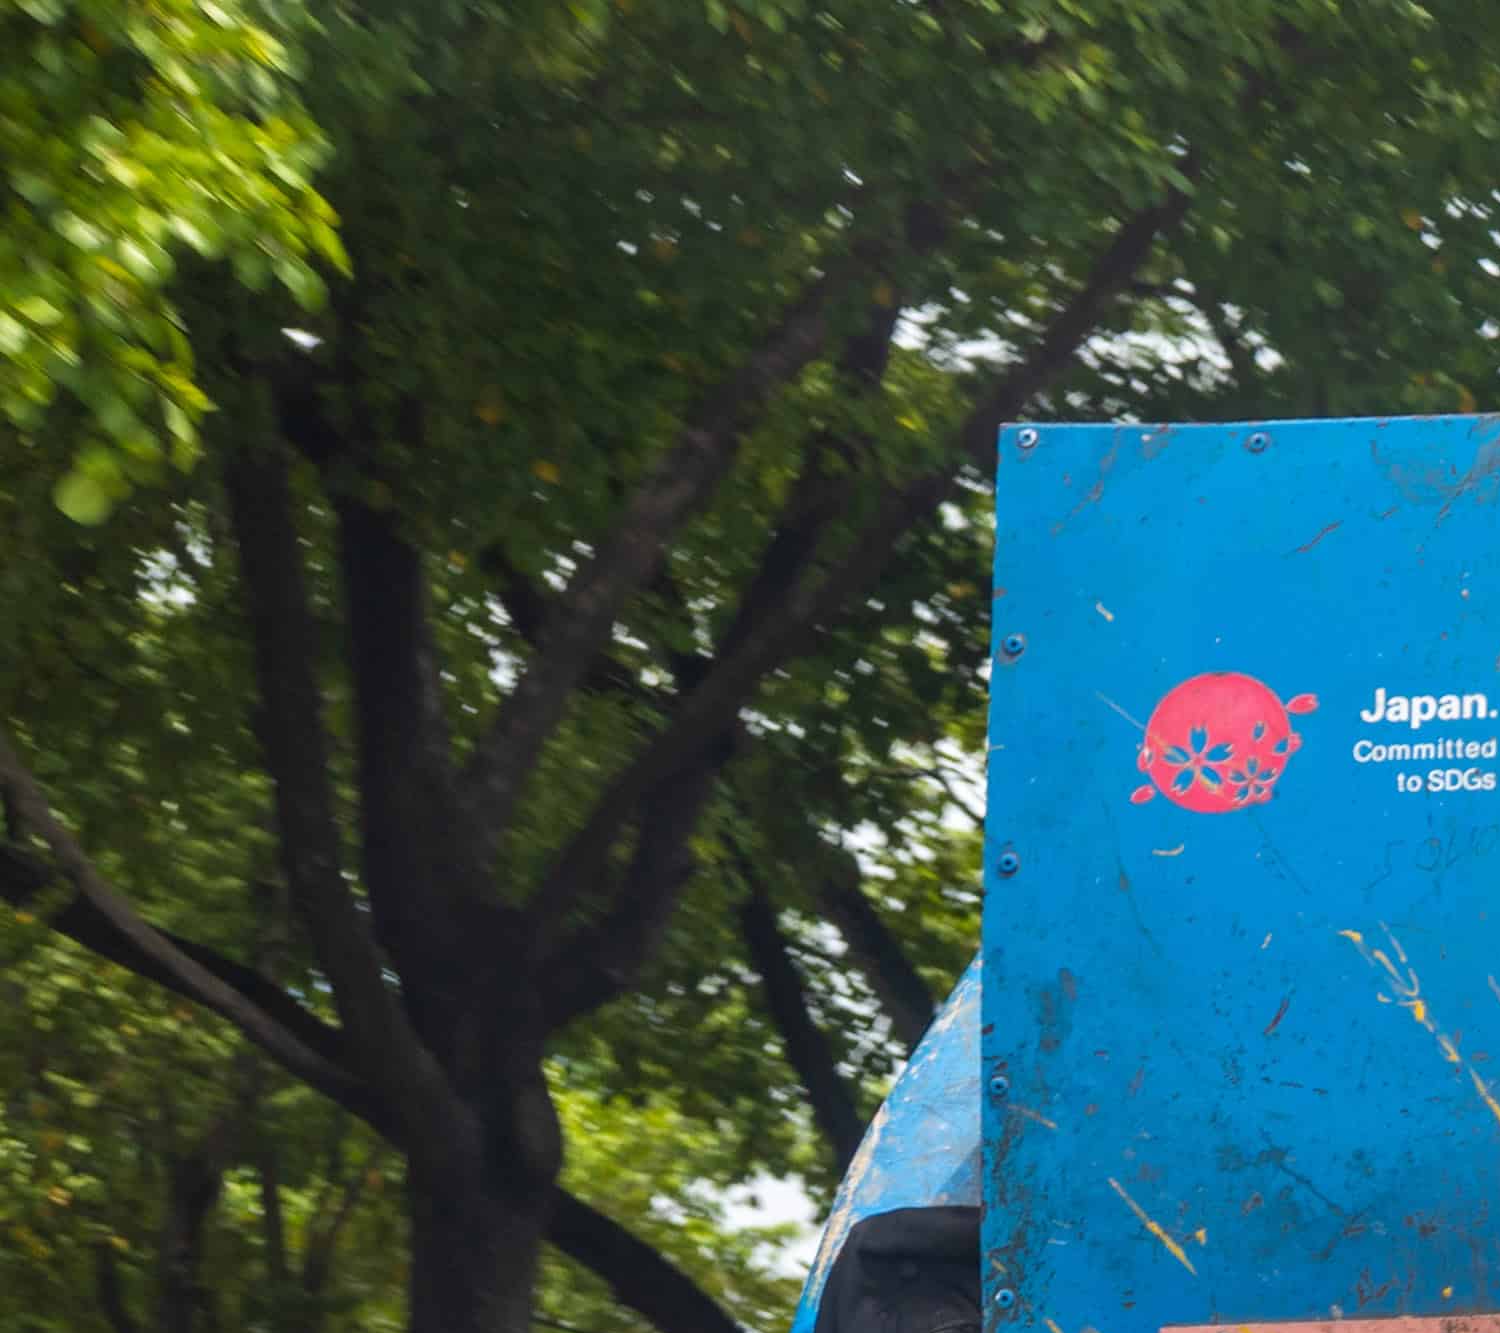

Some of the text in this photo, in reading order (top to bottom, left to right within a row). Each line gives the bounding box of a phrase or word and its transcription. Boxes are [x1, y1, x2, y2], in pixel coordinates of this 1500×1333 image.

[1360, 687, 1498, 729] Japan.
[1352, 737, 1498, 763] Committed
[1396, 768, 1497, 792] to SDGs
